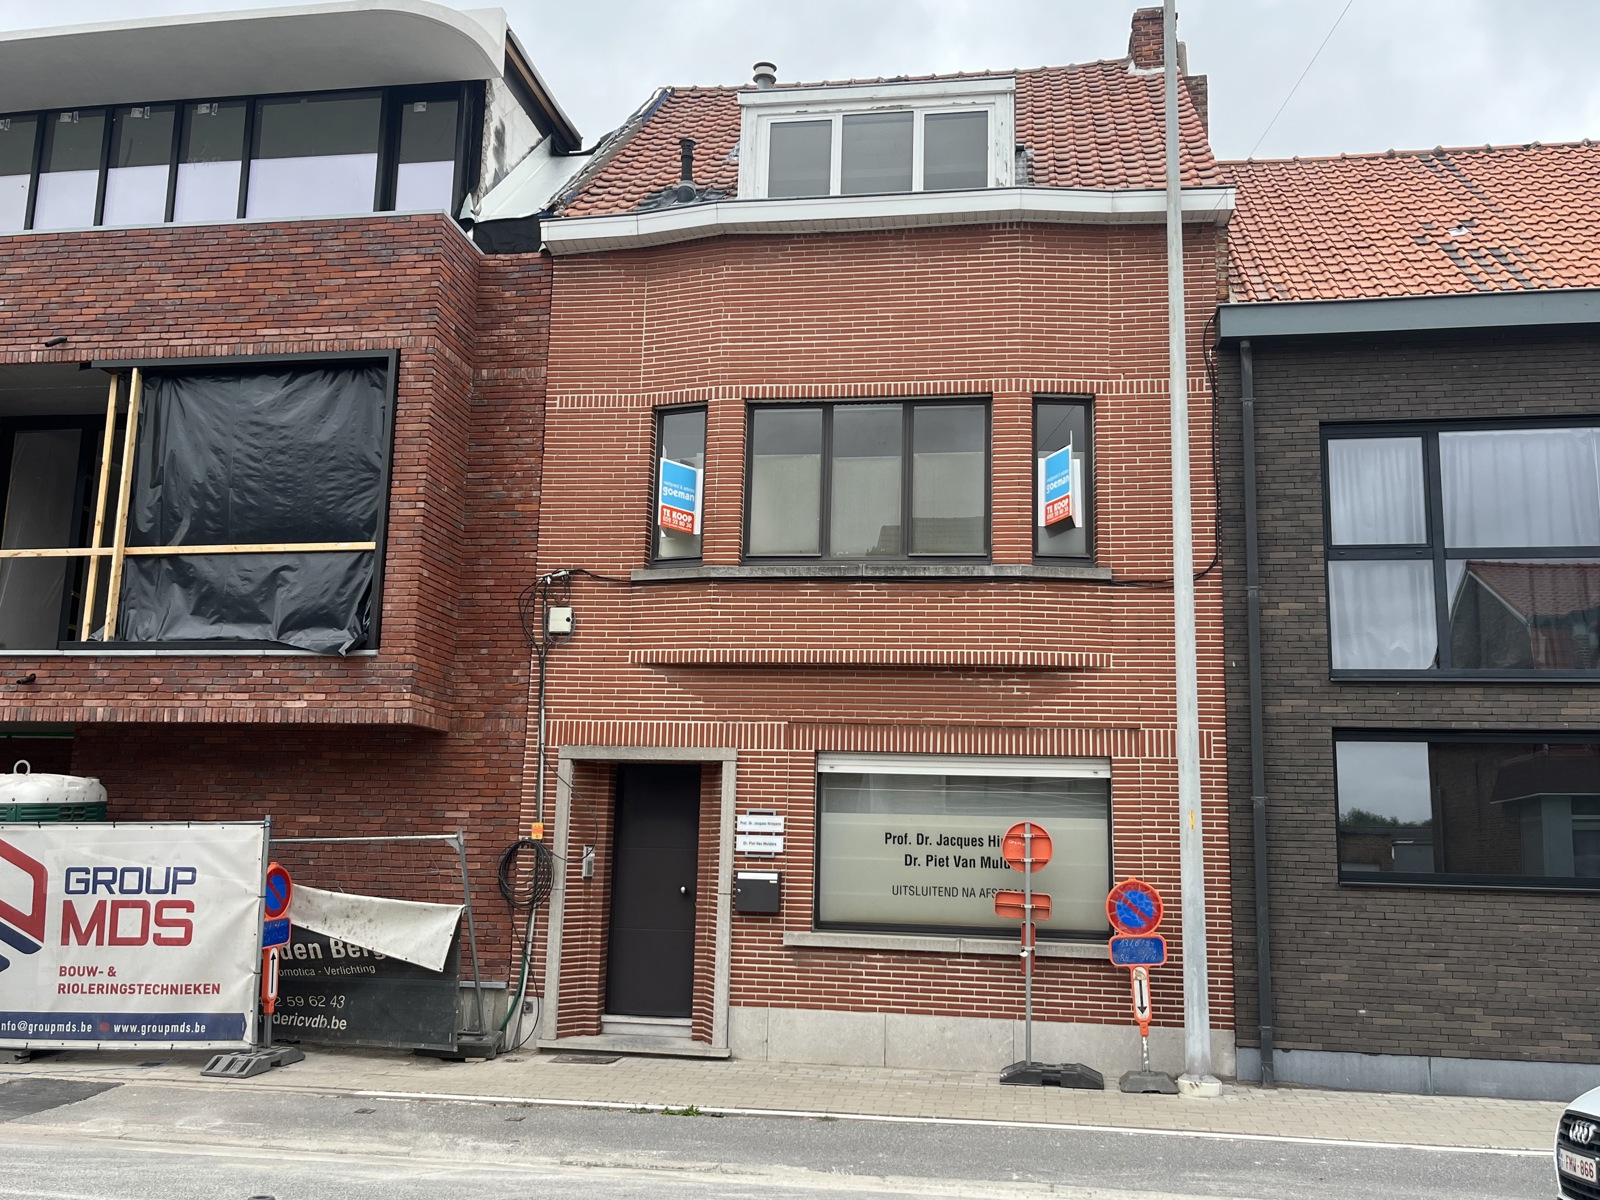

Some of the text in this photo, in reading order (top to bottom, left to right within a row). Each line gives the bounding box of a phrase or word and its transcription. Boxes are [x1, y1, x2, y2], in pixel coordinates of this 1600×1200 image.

[663, 486, 694, 502] goeman
[672, 512, 692, 522] KOOP
[884, 832, 1003, 849] Prof. Dr. Jacques Hi
[904, 854, 921, 867] Dr.
[926, 855, 949, 868] Piet
[953, 855, 976, 868] Van
[65, 867, 197, 895] GROUP
[892, 885, 959, 898] UITSLUITEND
[962, 887, 976, 898] NA
[61, 899, 195, 946] MDS
[280, 942, 323, 960] den
[59, 966, 117, 977] BOUW- &
[279, 967, 316, 977] omotica
[323, 965, 376, 976] Verlichting
[57, 983, 221, 995] RIOLERINGSTECHNIEKEN
[286, 995, 304, 1007] 59
[308, 995, 326, 1007] 62
[329, 994, 346, 1009] 43
[113, 1021, 206, 1036] www.groupmds.be
